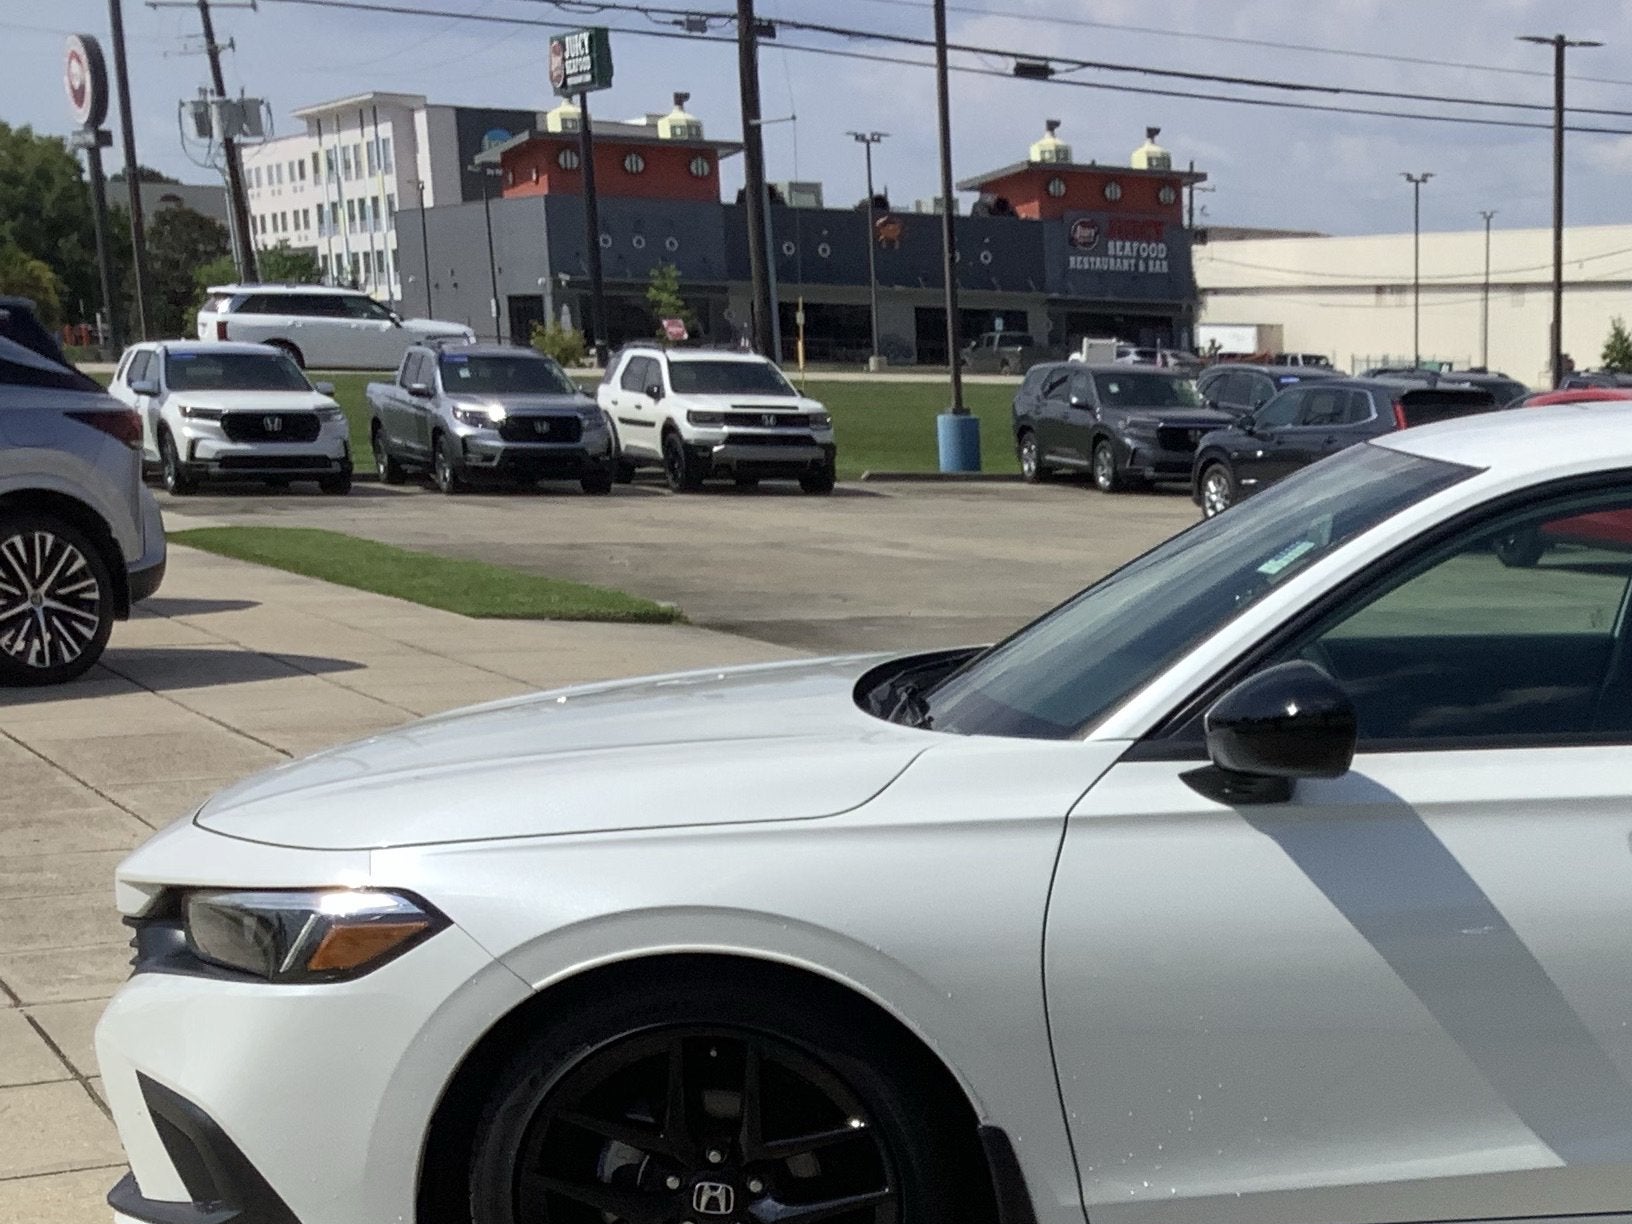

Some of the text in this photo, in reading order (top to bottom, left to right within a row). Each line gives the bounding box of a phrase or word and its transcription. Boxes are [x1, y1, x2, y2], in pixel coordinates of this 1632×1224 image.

[564, 32, 590, 58] JUICY
[1107, 241, 1168, 258] SEAFOOD
[1069, 256, 1136, 271] RESTAURANT
